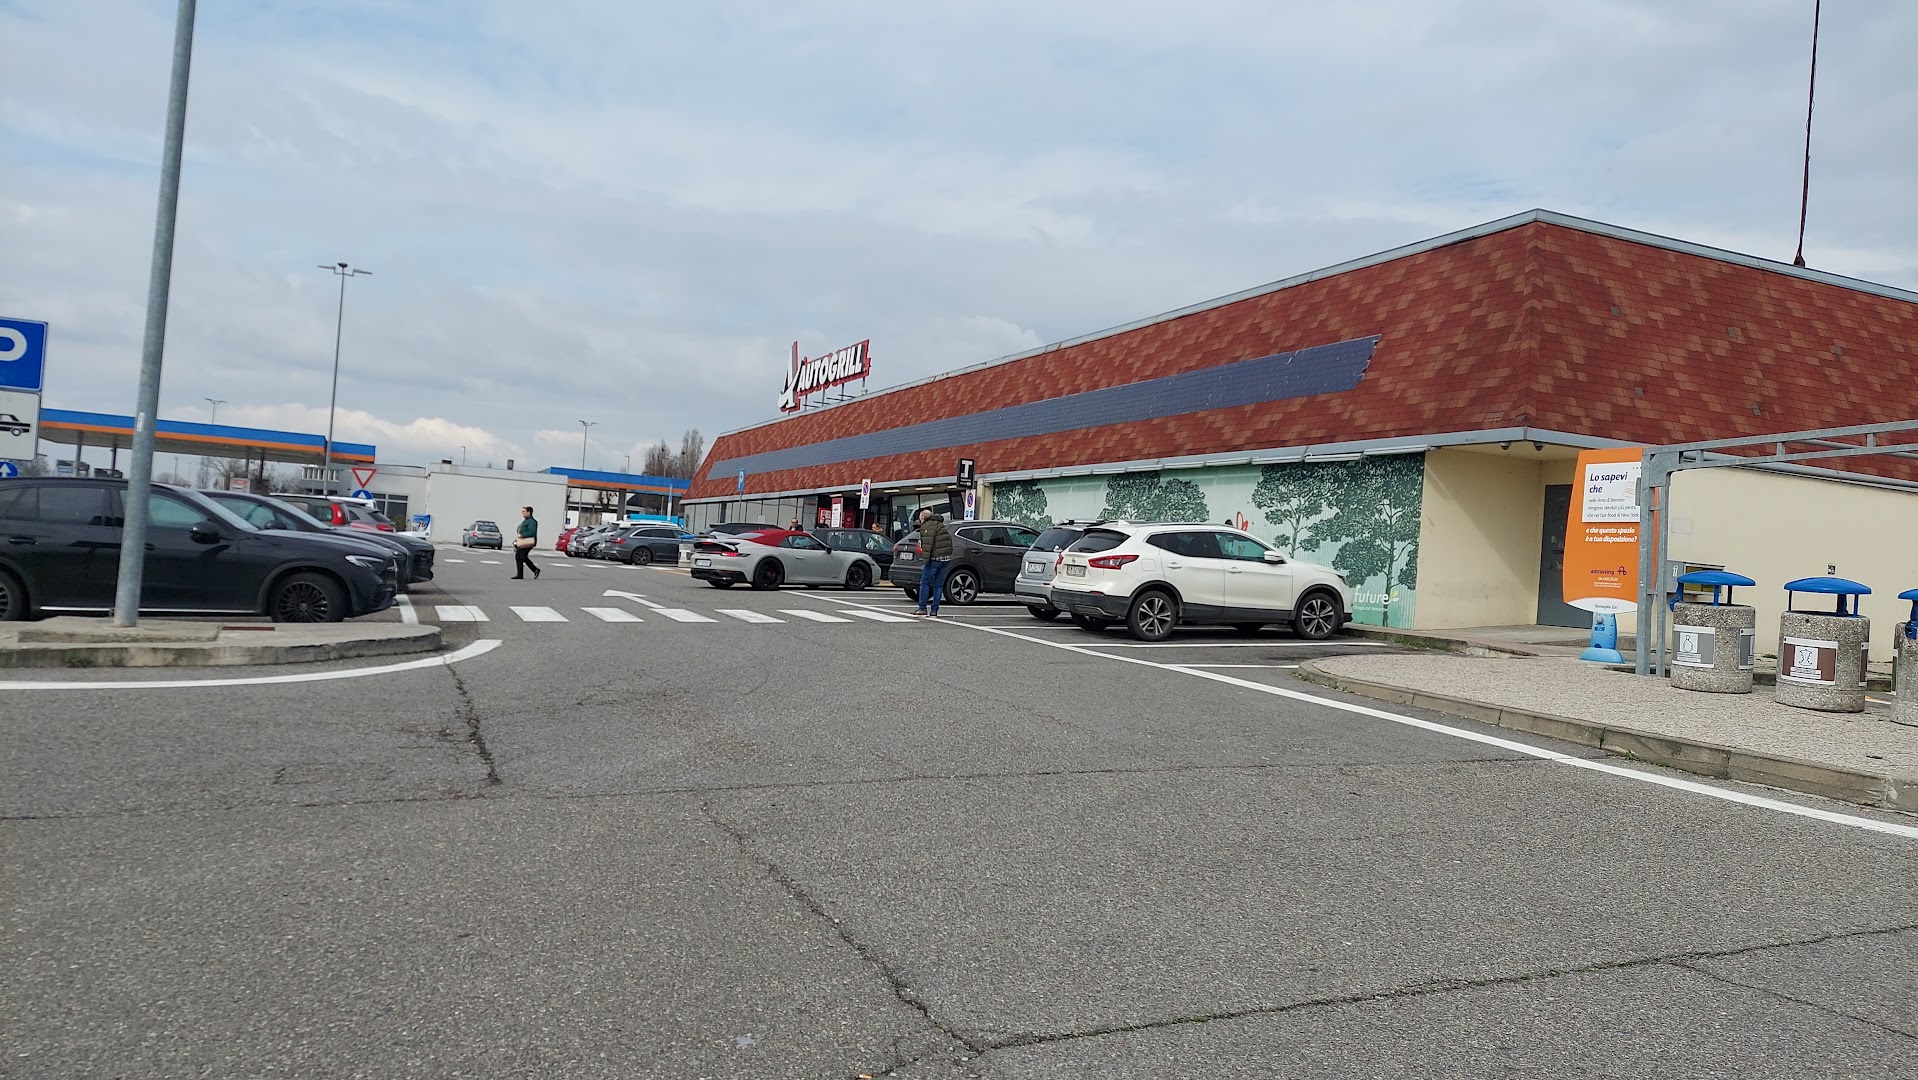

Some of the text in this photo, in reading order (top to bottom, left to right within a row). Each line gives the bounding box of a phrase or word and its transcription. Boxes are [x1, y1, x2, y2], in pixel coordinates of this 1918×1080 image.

[797, 344, 863, 392] AUTOGRILL
[1589, 471, 1628, 484] Lo sapevi
[1589, 485, 1603, 493] che
[1599, 527, 1617, 535] questo
[1617, 527, 1635, 535] spazio
[1603, 536, 1638, 544] disposizione?
[1354, 584, 1391, 605] future
